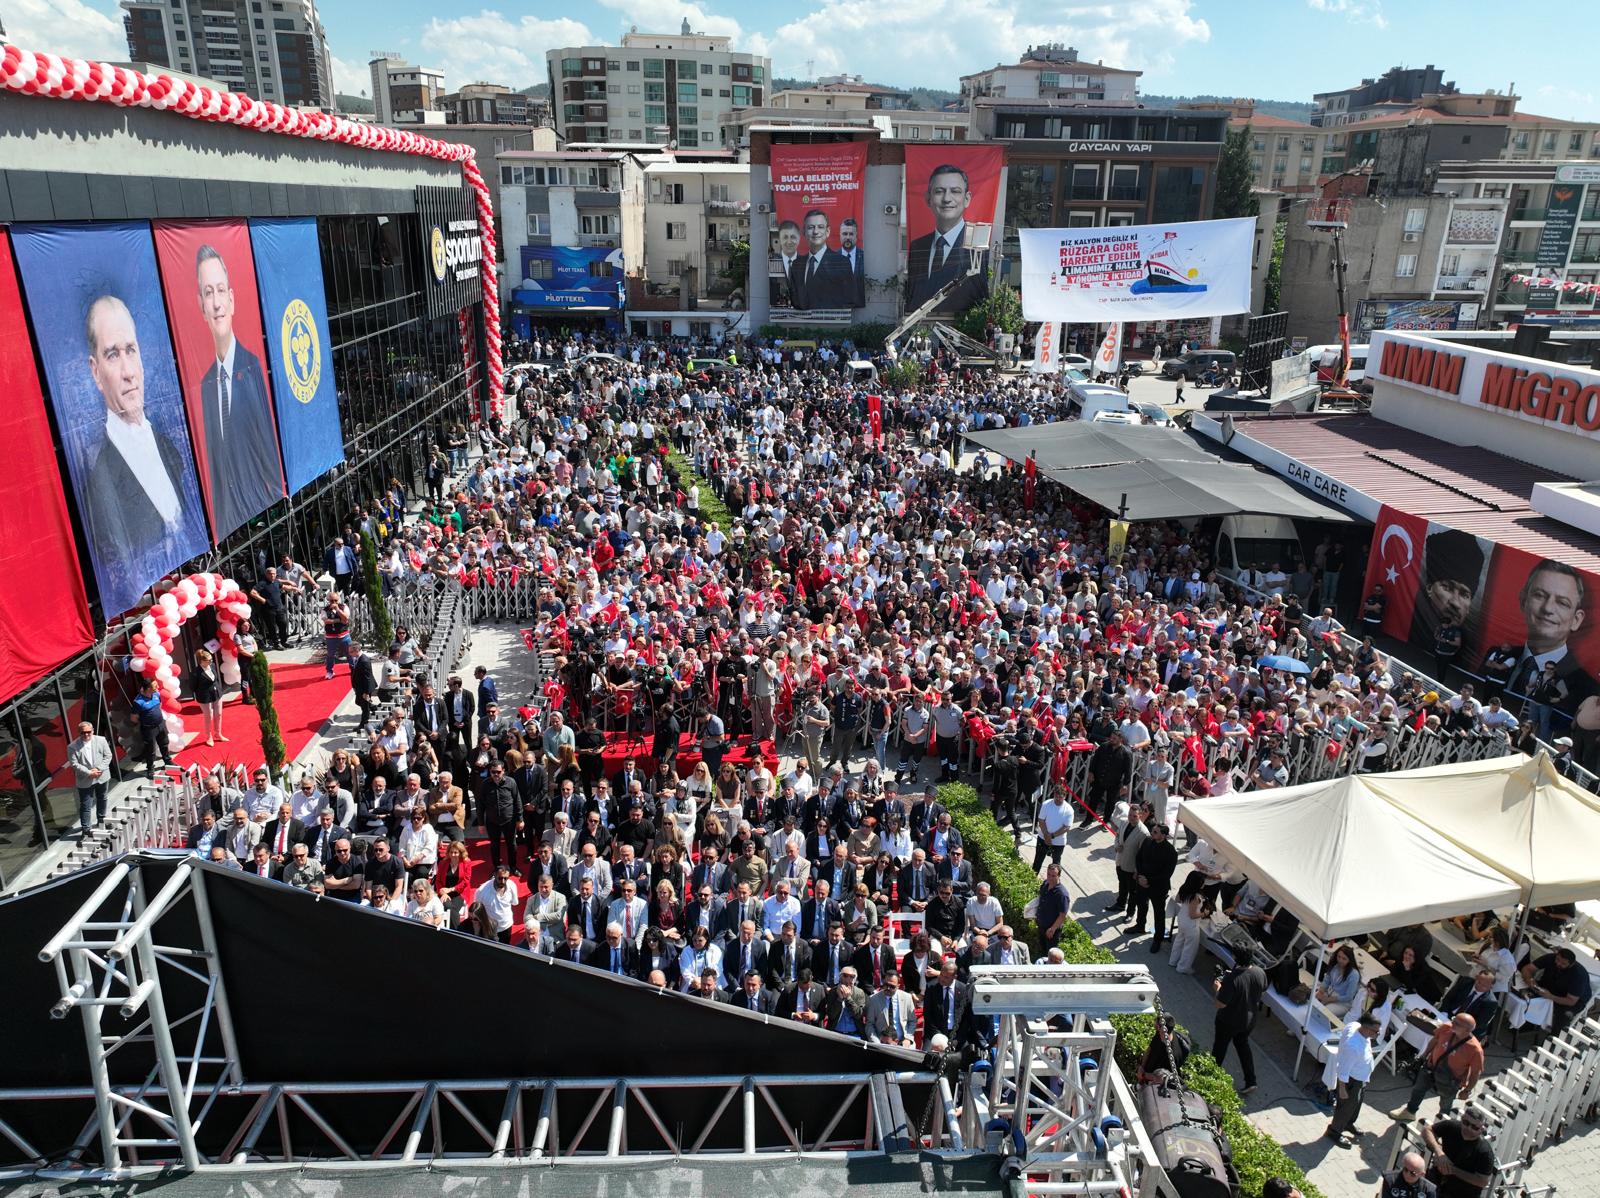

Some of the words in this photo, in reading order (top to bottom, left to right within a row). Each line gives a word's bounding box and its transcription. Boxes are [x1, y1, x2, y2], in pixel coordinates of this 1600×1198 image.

[1079, 143, 1120, 152] AYCAN
[1126, 144, 1153, 152] YAPI
[781, 175, 805, 183] BUCA
[806, 172, 853, 182] BELEDİYESİ
[774, 184, 801, 192] TOPLU
[803, 183, 830, 193] AÇILIŞ
[831, 180, 859, 191] TÖRENİ
[1074, 238, 1101, 246] KALYON
[1060, 254, 1105, 266] HAREKET
[1115, 260, 1138, 271] HALK
[545, 293, 564, 302] PİLOT
[564, 295, 586, 303] TEKEL
[1379, 340, 1466, 395] MMM
[1287, 462, 1311, 483] CAR
[1314, 475, 1348, 503] CARE
